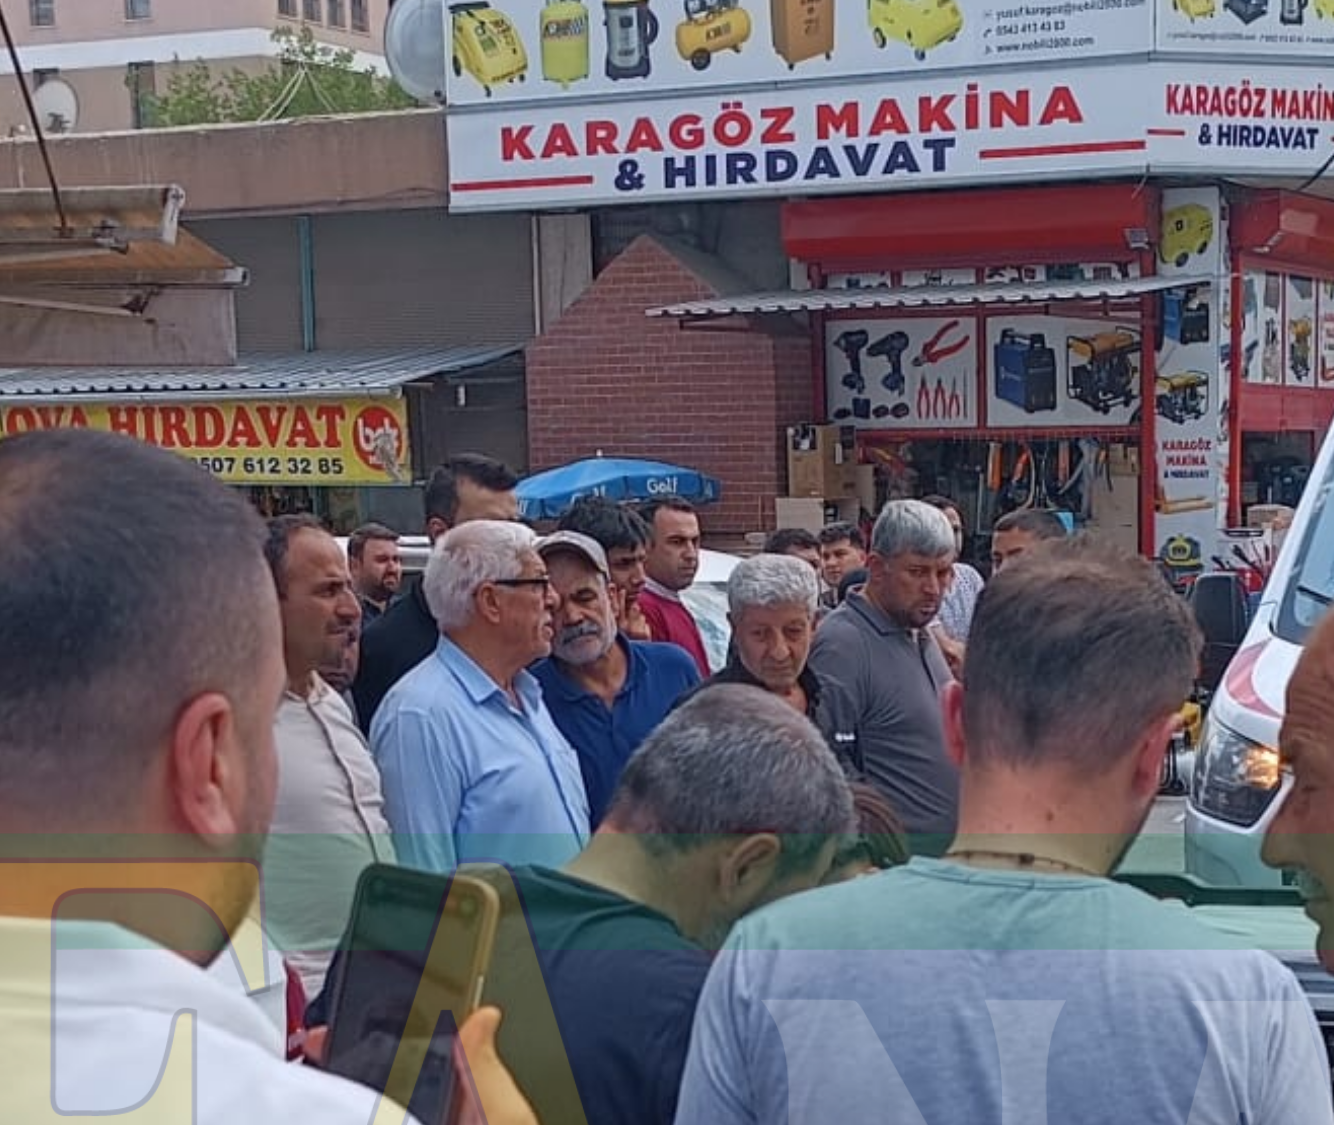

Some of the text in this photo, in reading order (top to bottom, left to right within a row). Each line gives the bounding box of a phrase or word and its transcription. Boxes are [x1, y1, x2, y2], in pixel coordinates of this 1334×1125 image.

[1166, 79, 1266, 119] KARAGÖZ
[500, 83, 1084, 161] KARAGÖZ MAKİNA
[1198, 123, 1320, 150] & HIRDAVAT
[613, 138, 956, 192] & HIRDAVAT
[107, 405, 346, 449] HIRDAVAT
[190, 457, 344, 474] 507 612 32 85
[646, 476, 679, 494] Golf
